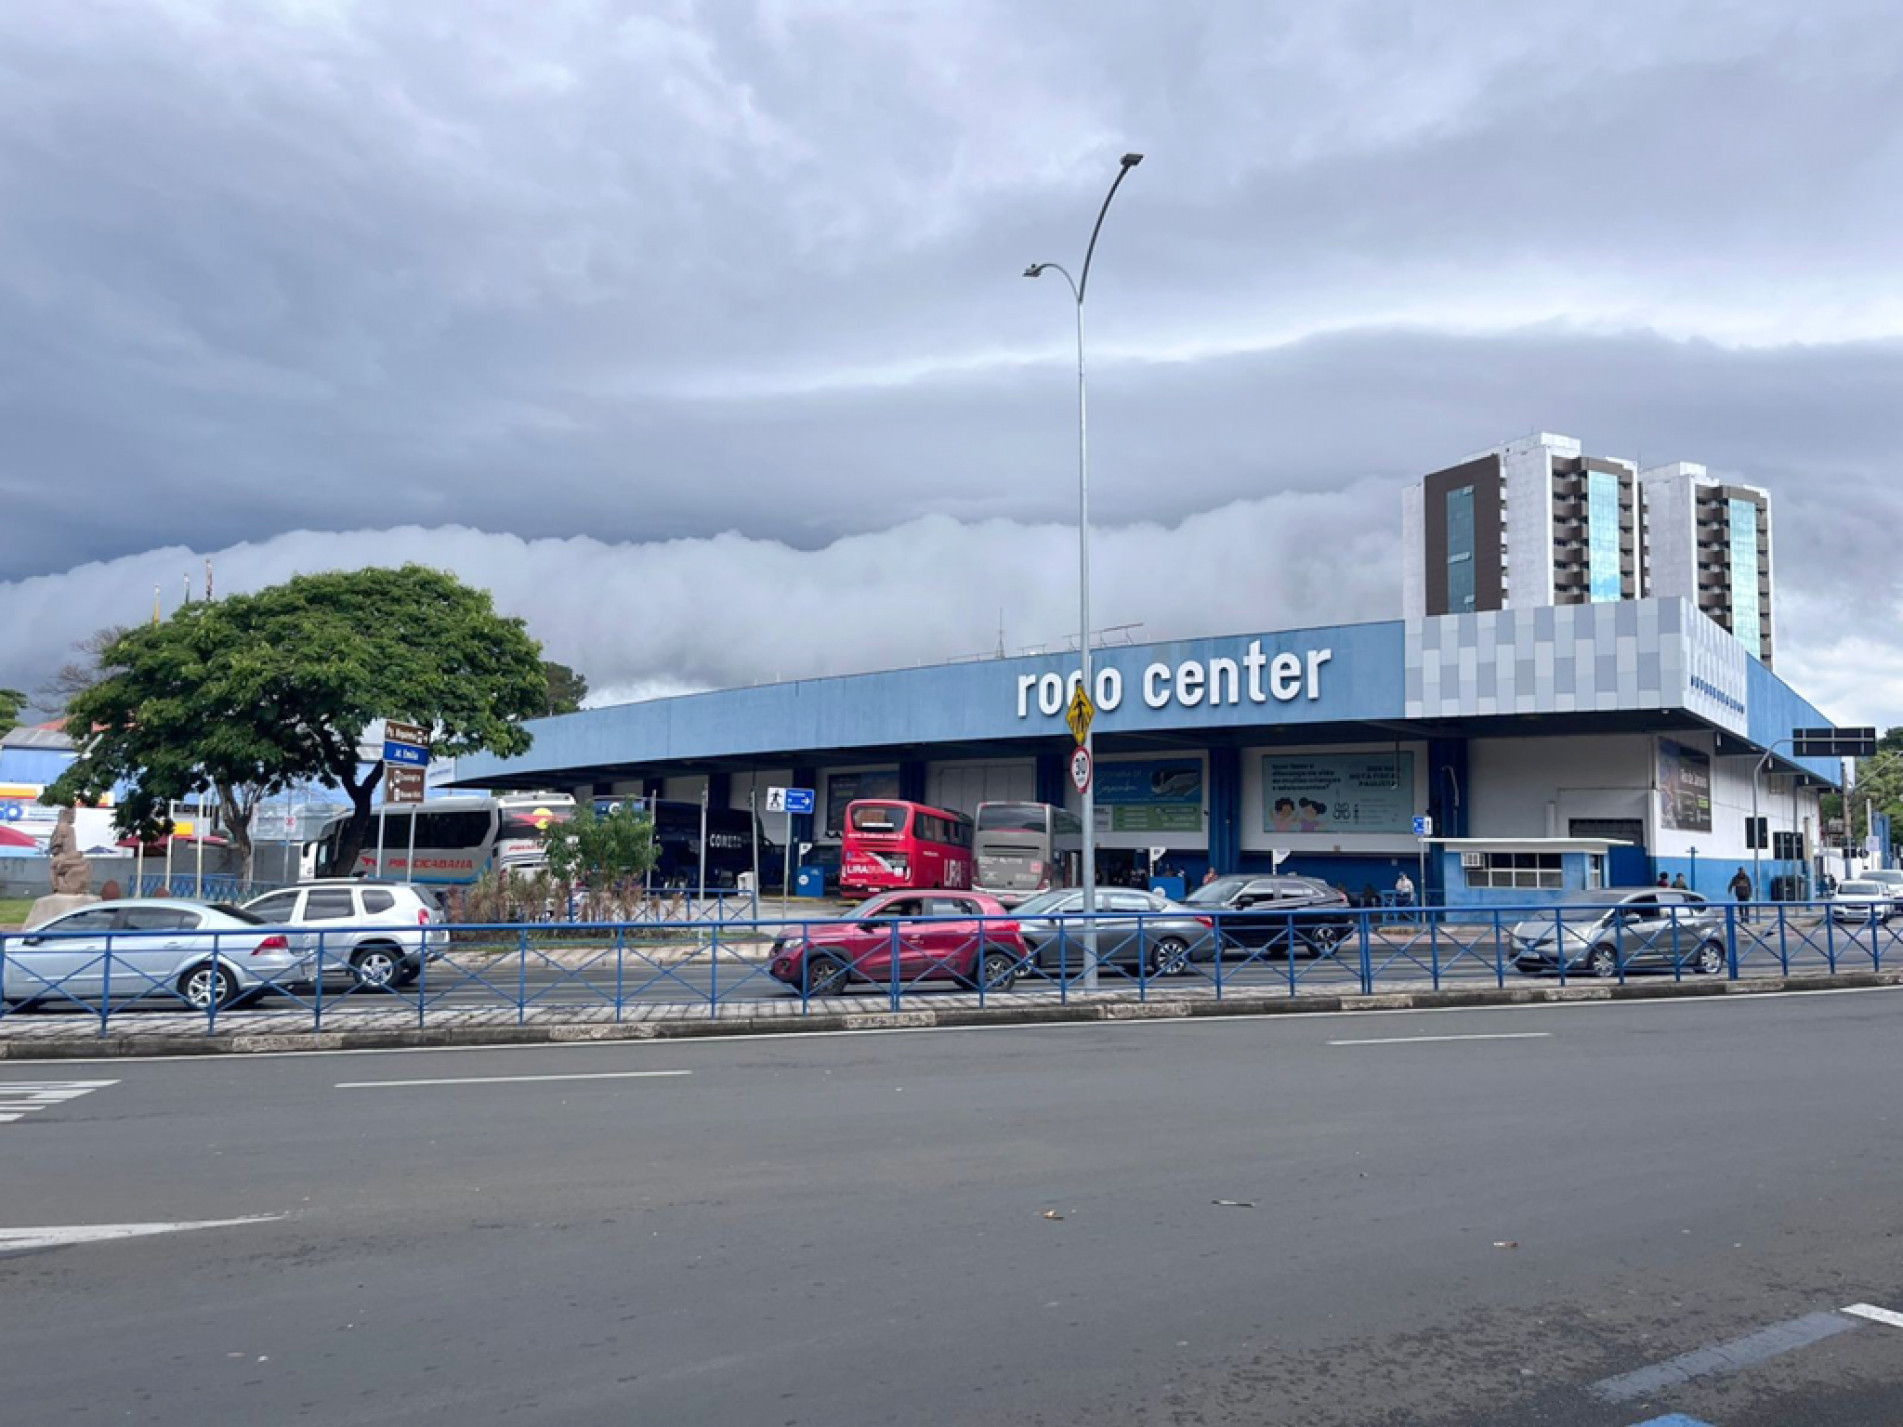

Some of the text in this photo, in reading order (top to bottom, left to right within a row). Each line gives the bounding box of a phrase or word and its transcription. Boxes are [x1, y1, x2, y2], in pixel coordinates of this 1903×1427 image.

[1144, 639, 1331, 708] center
[1075, 757, 1087, 775] 30
[388, 858, 473, 869] PIRCICABANA
